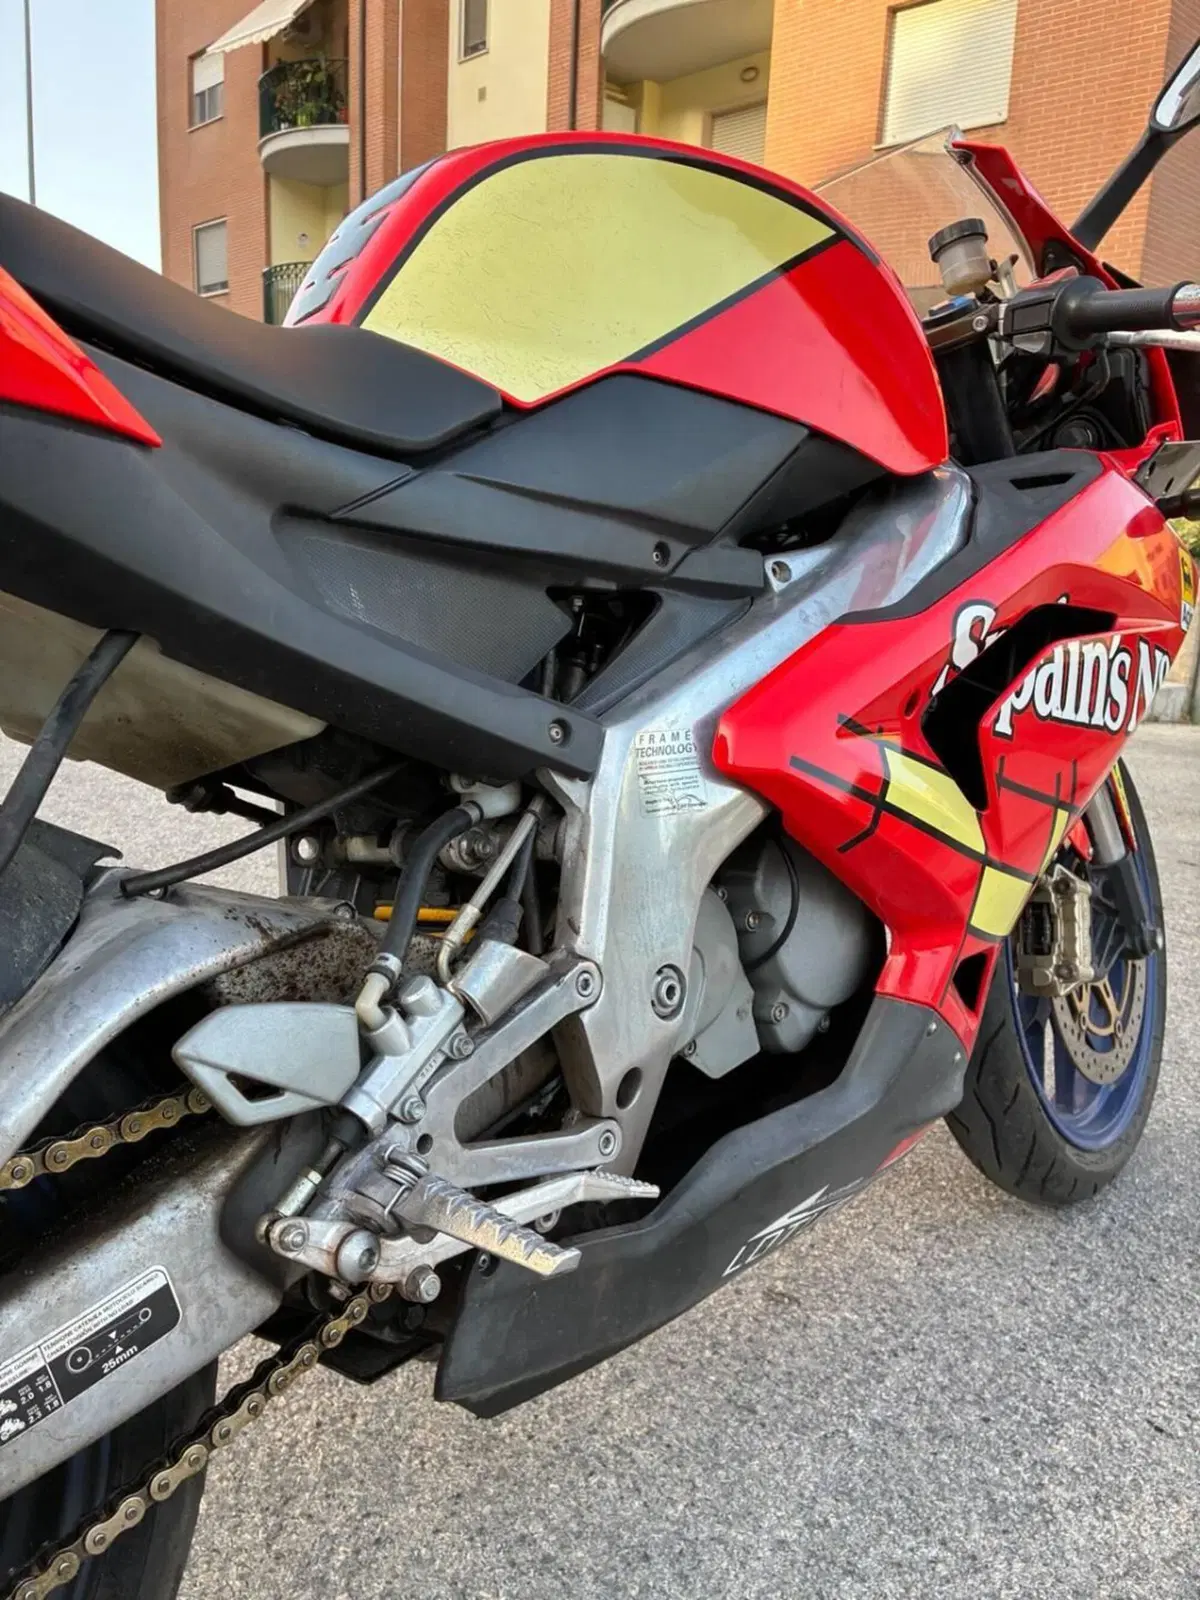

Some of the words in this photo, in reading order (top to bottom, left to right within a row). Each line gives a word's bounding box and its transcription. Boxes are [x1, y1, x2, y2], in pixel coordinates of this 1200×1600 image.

[639, 730, 691, 744] FRAME
[635, 743, 697, 758] TECHNOLOGY
[102, 1344, 138, 1373] 25mm
